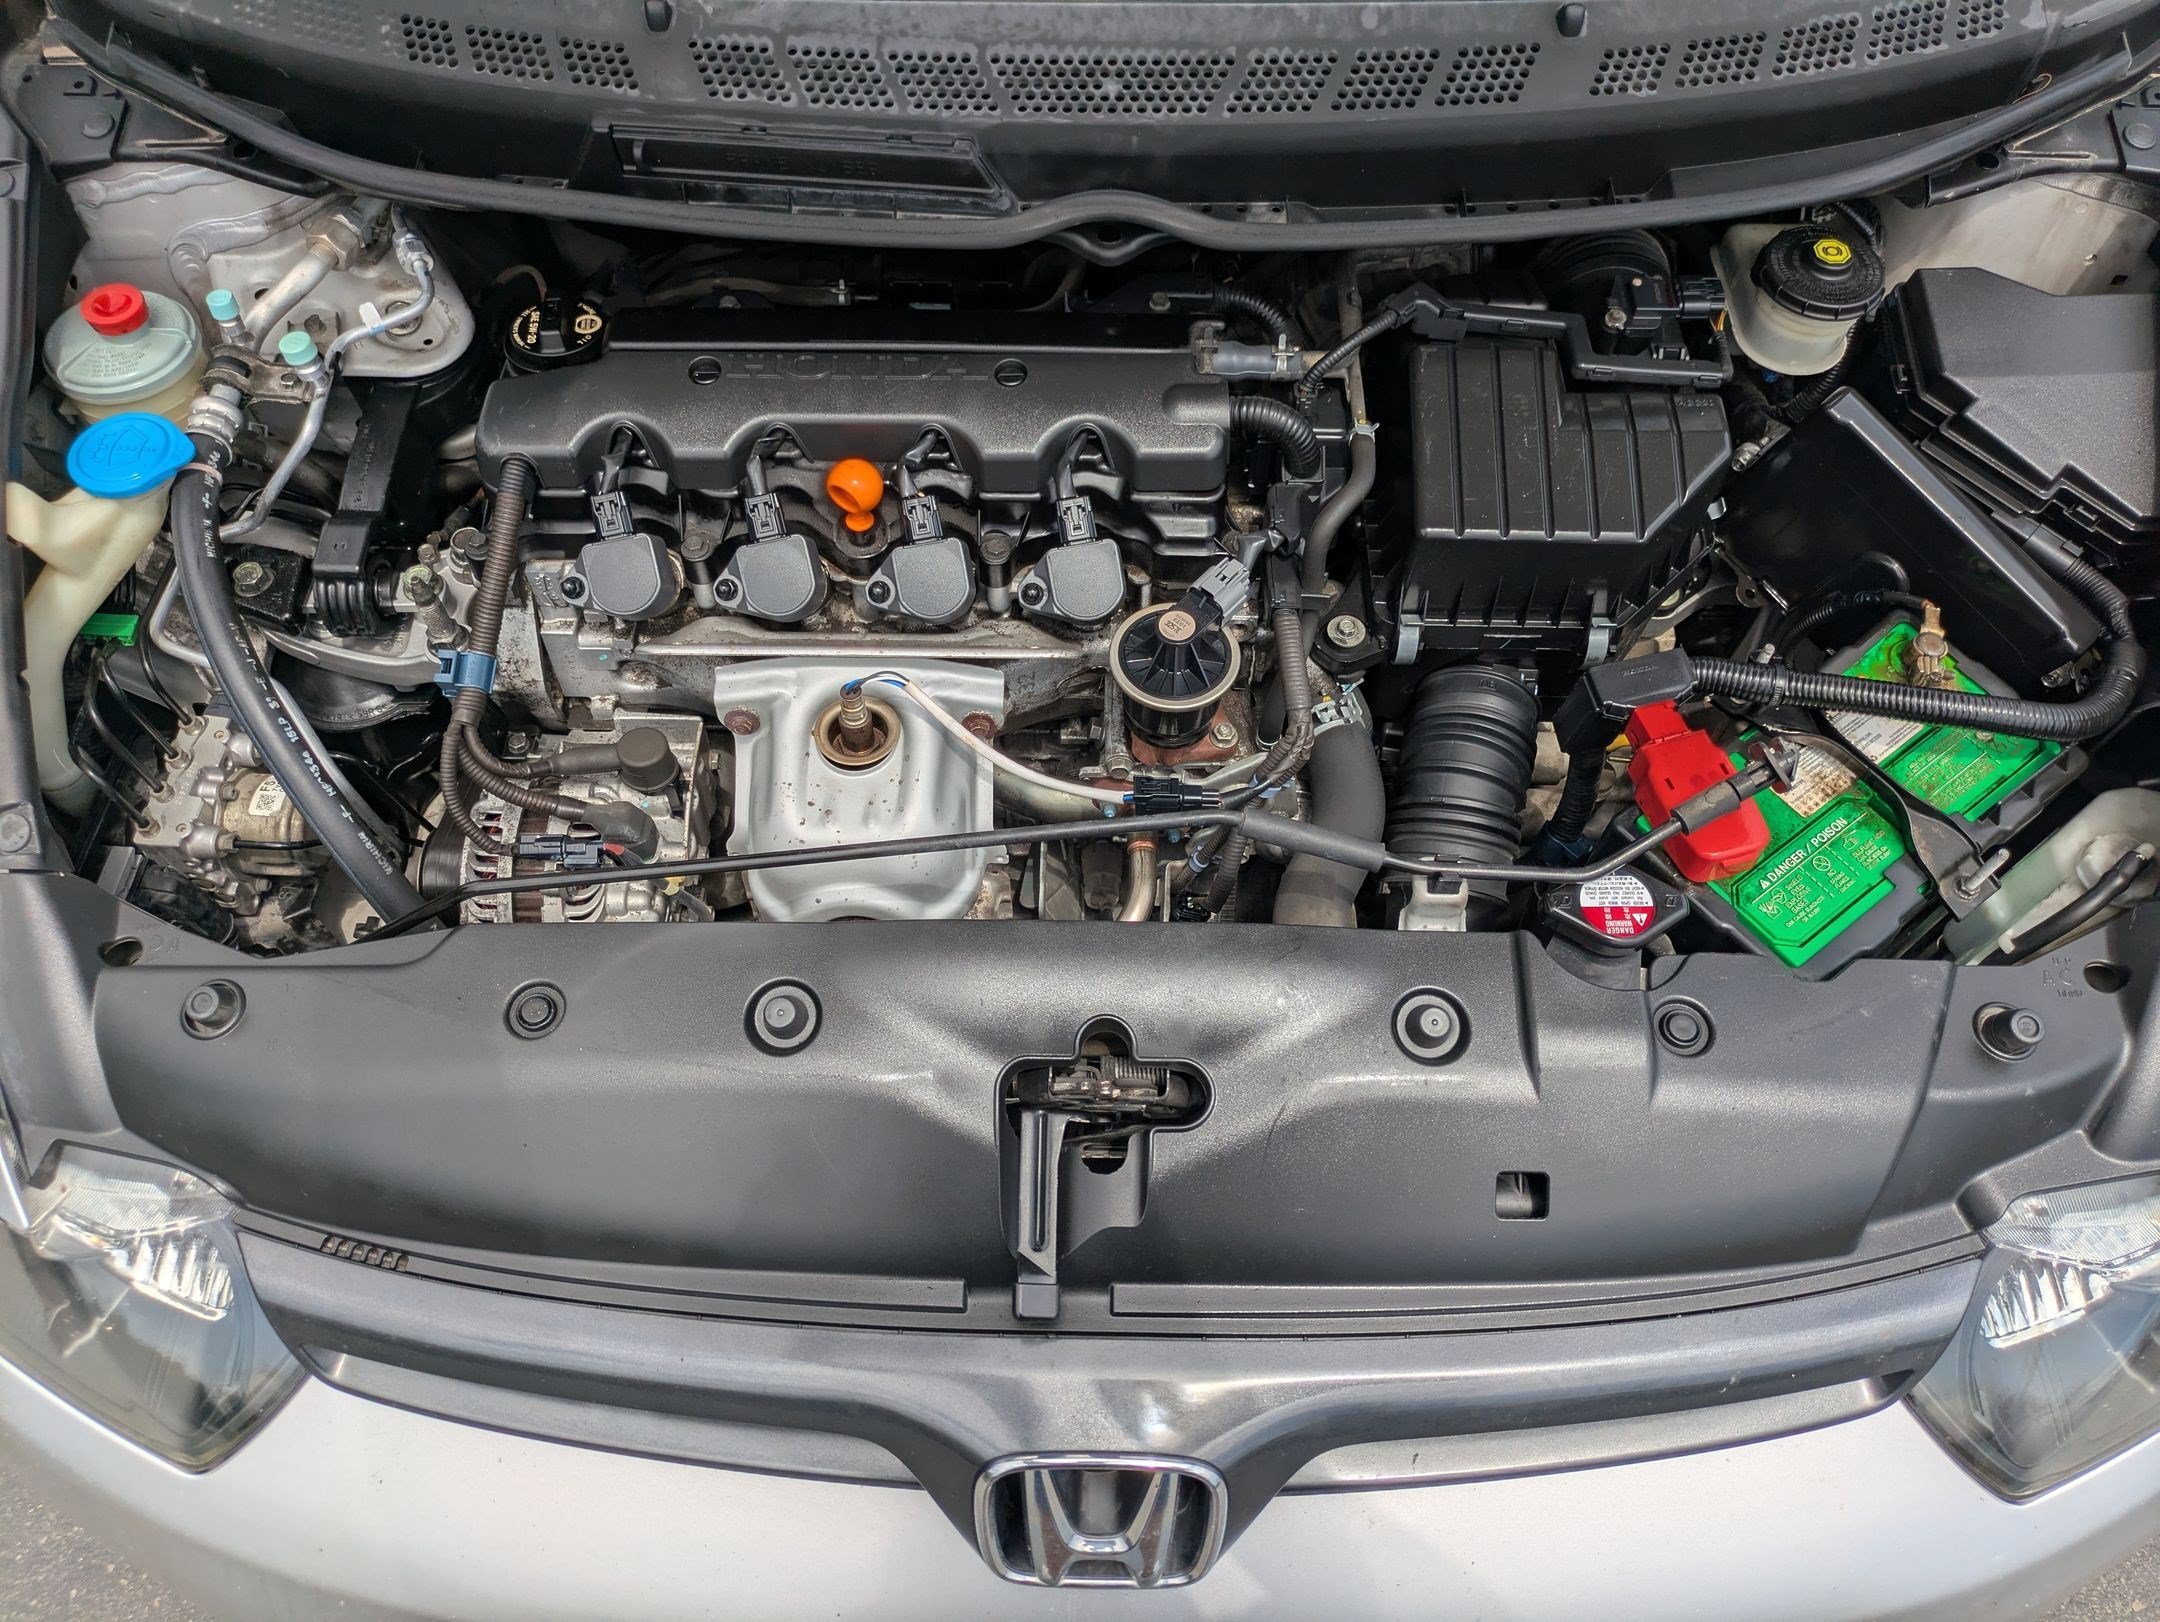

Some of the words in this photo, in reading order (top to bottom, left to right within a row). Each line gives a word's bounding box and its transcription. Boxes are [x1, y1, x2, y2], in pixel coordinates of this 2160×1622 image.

[531, 311, 540, 322] SAE
[527, 323, 538, 343] 5W-20
[576, 334, 591, 344] OIL
[726, 353, 989, 381] HONDA
[1766, 848, 1807, 882] DANGER
[1806, 843, 1810, 853] /
[1810, 816, 1848, 847] POISON
[1784, 874, 1803, 891] SHIELD
[1790, 883, 1805, 895] EYES
